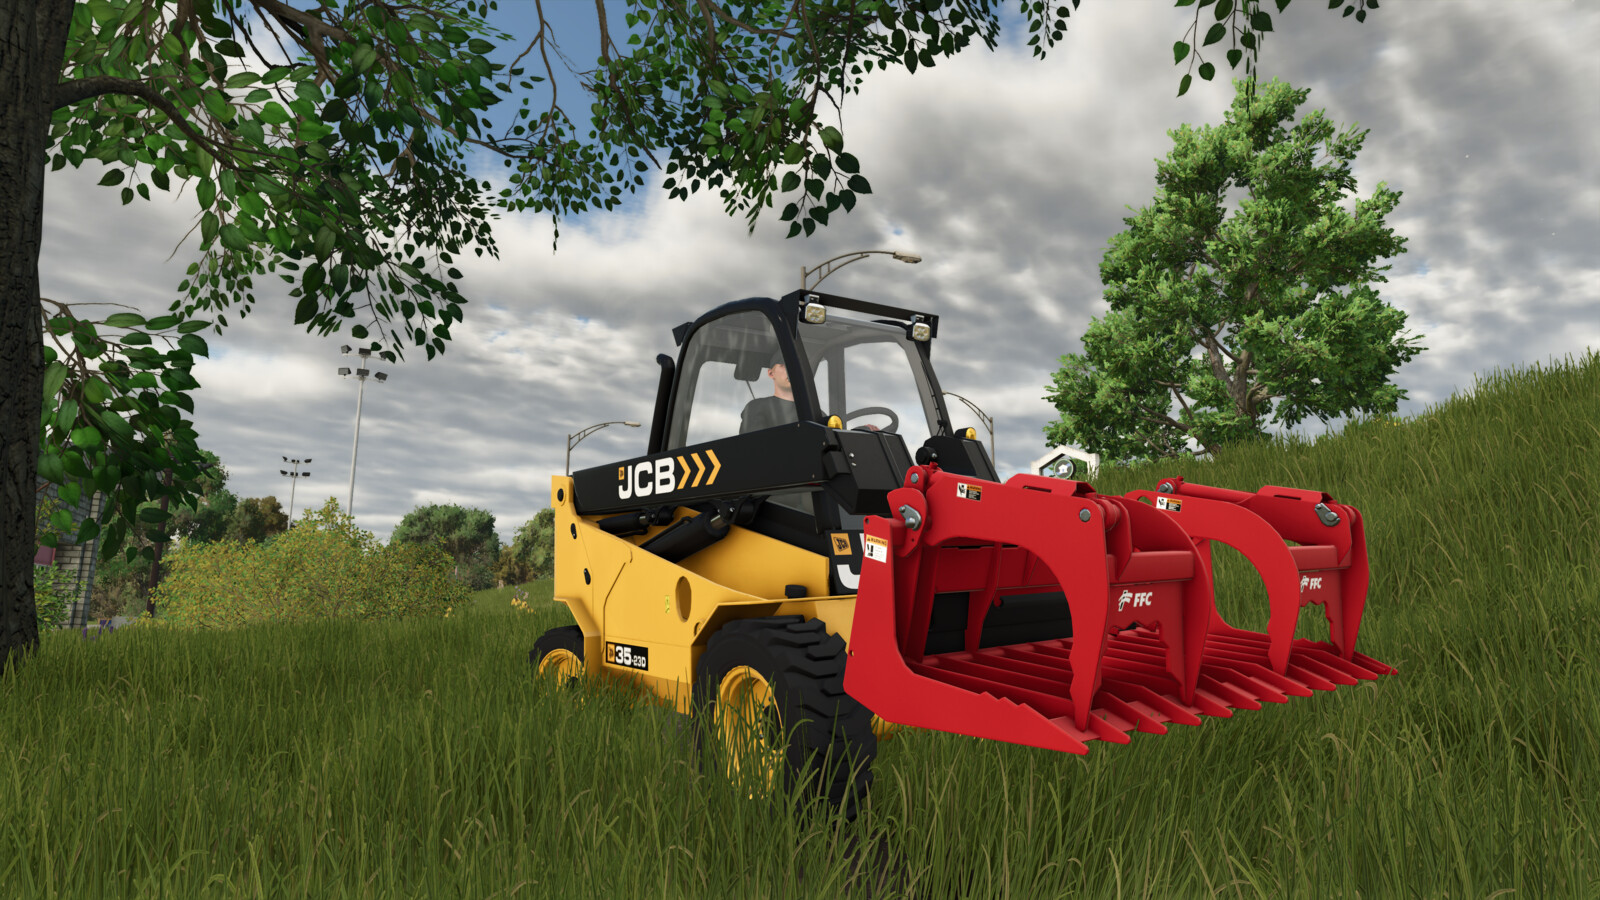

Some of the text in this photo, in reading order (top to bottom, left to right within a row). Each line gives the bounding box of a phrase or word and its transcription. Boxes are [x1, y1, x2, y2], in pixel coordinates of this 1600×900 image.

[618, 457, 676, 500] JCB
[1309, 577, 1322, 590] FFC
[1133, 592, 1153, 608] FFC
